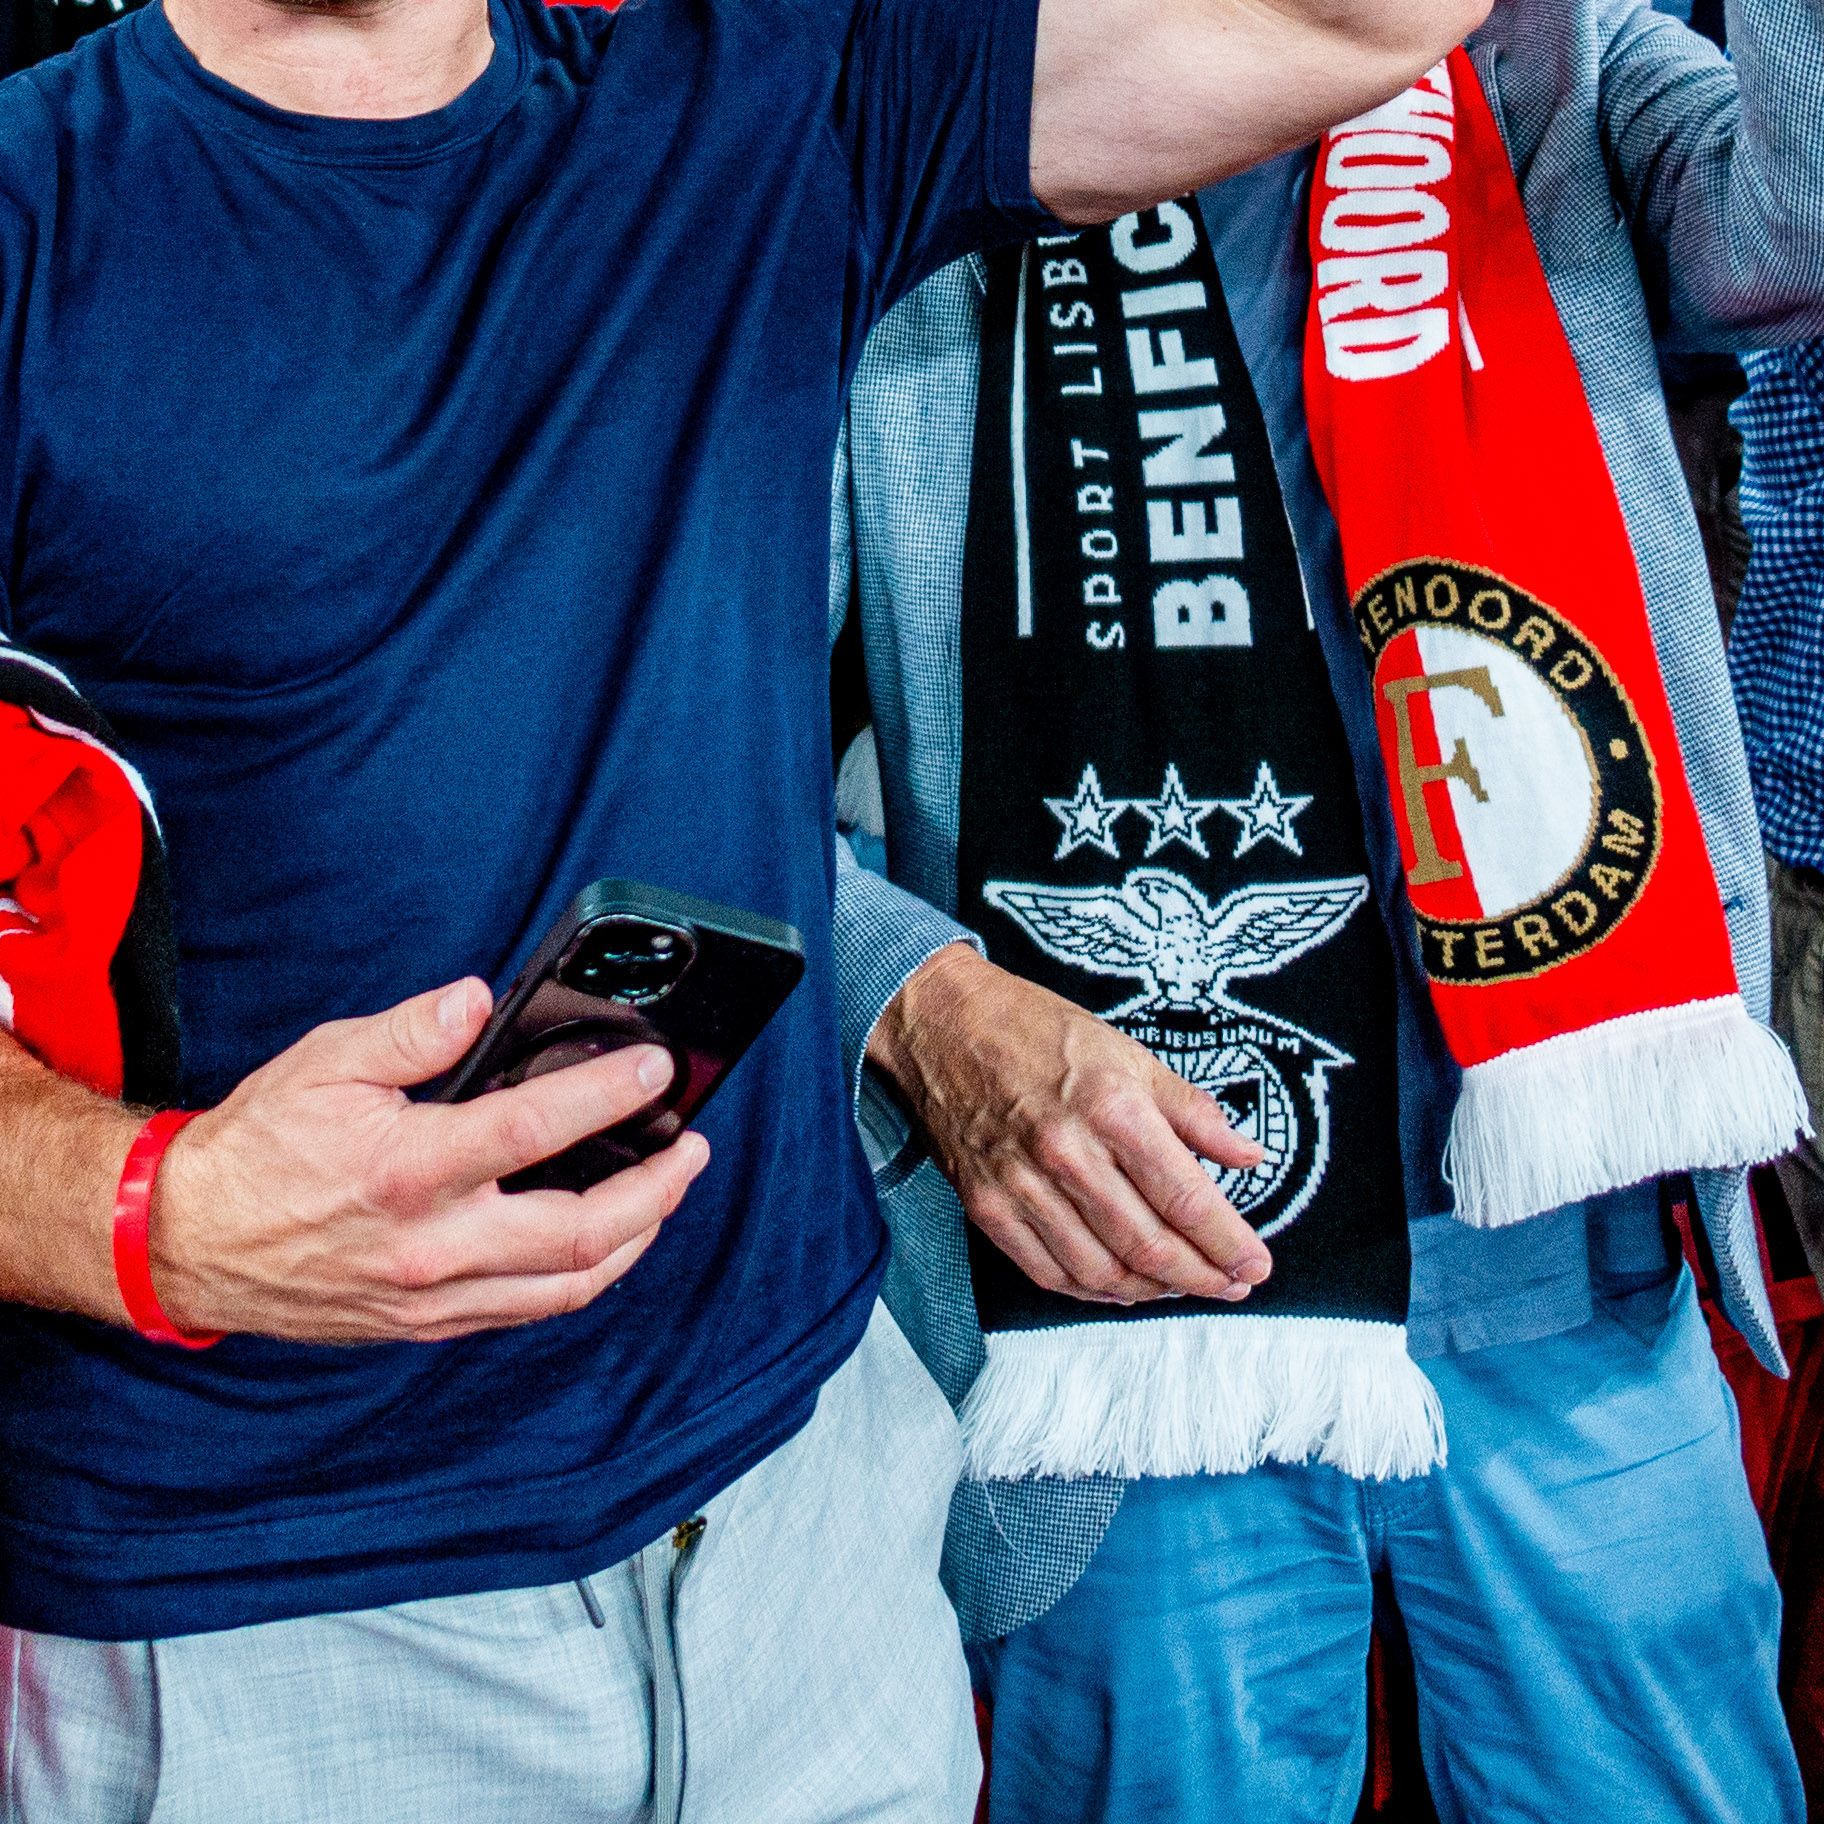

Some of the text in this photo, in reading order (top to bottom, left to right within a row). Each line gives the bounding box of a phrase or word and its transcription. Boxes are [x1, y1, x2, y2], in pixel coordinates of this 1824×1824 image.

[1037, 231, 1126, 651] SPORT LISB
[1110, 192, 1254, 648] BENFIC
[1383, 665, 1506, 886] F
[1418, 807, 1646, 970] TERDAM
